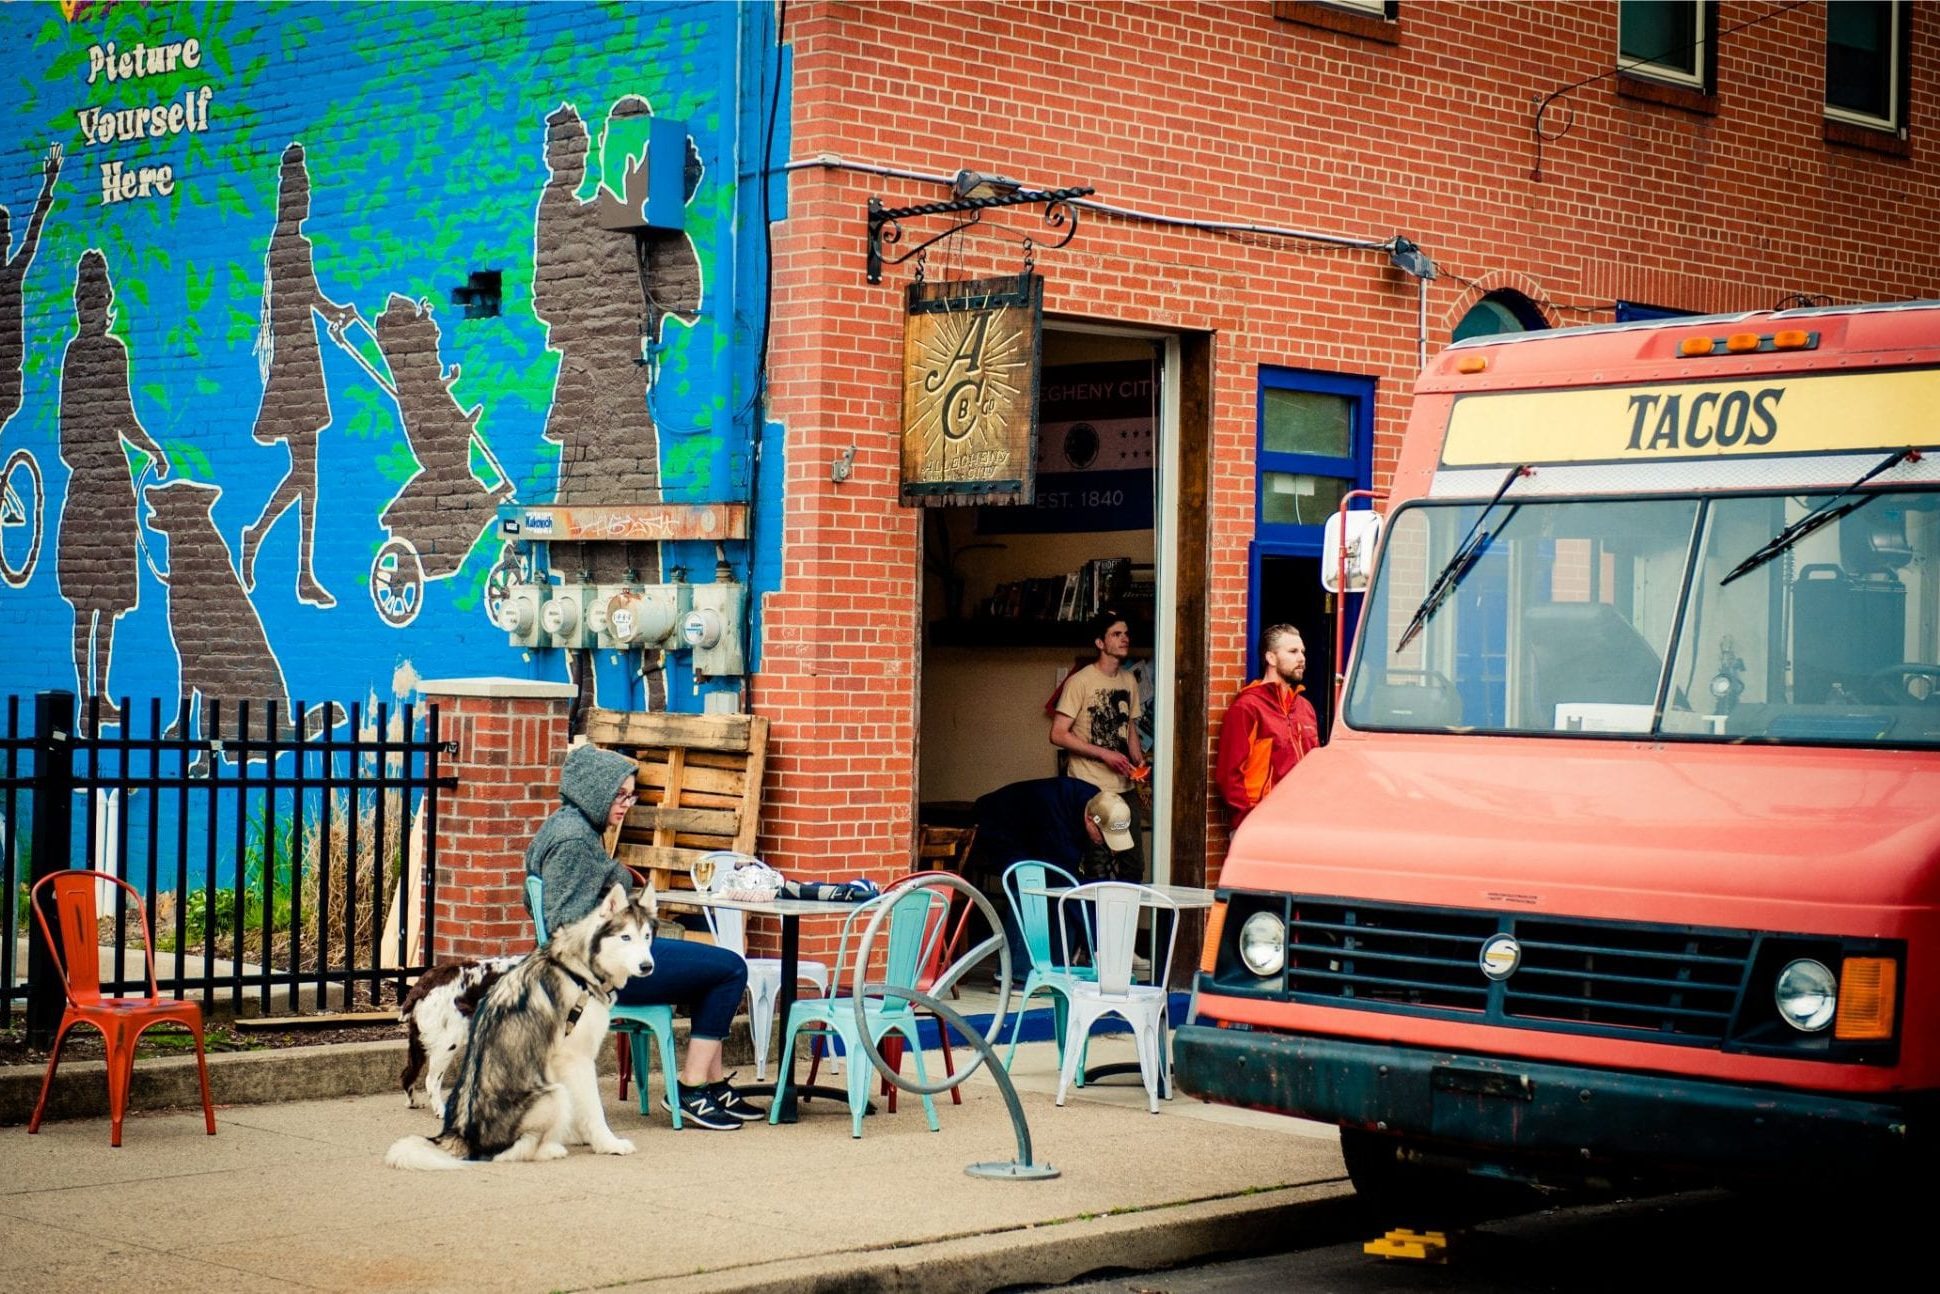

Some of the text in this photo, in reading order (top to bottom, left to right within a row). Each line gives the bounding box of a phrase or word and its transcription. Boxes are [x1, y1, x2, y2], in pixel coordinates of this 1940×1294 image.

[86, 37, 201, 84] Picture
[77, 85, 213, 147] Yourself
[100, 160, 176, 206] Here
[925, 310, 994, 393] A
[1040, 379, 1160, 403] EGHENY CITY
[941, 378, 986, 440] C
[957, 398, 970, 422] B
[1625, 387, 1787, 451] TACOS
[920, 449, 1011, 473] ALLEGHENY
[967, 465, 998, 480] CITY
[1036, 489, 1124, 509] EST. 1840
[689, 1097, 715, 1116] N
[717, 1090, 740, 1108] N
